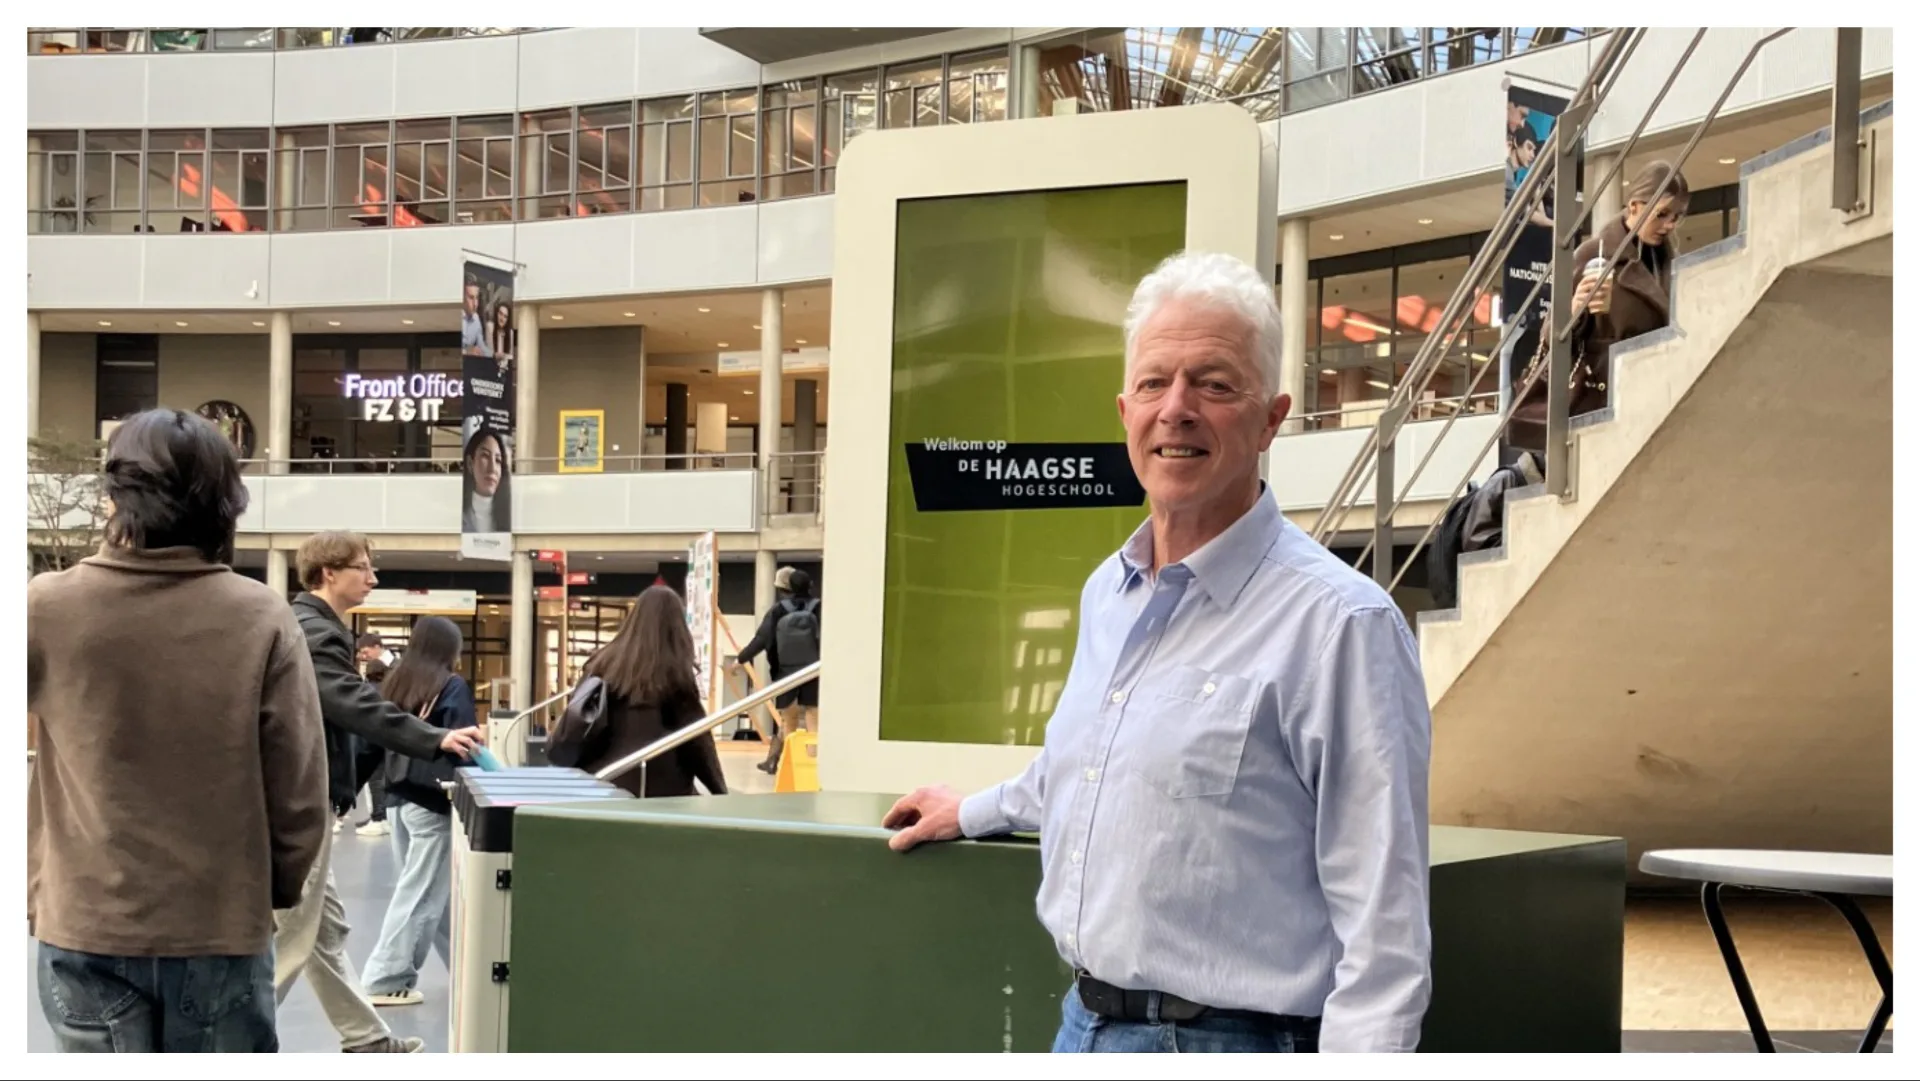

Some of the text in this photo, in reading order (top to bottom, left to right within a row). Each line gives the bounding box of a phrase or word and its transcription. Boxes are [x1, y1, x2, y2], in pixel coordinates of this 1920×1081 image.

[345, 374, 406, 398] Front
[365, 398, 444, 421] FZ & IT
[924, 437, 1007, 453] Welkom op
[958, 457, 1095, 480] DE HAAGSE
[1002, 483, 1115, 496] HOGESCHOOL
